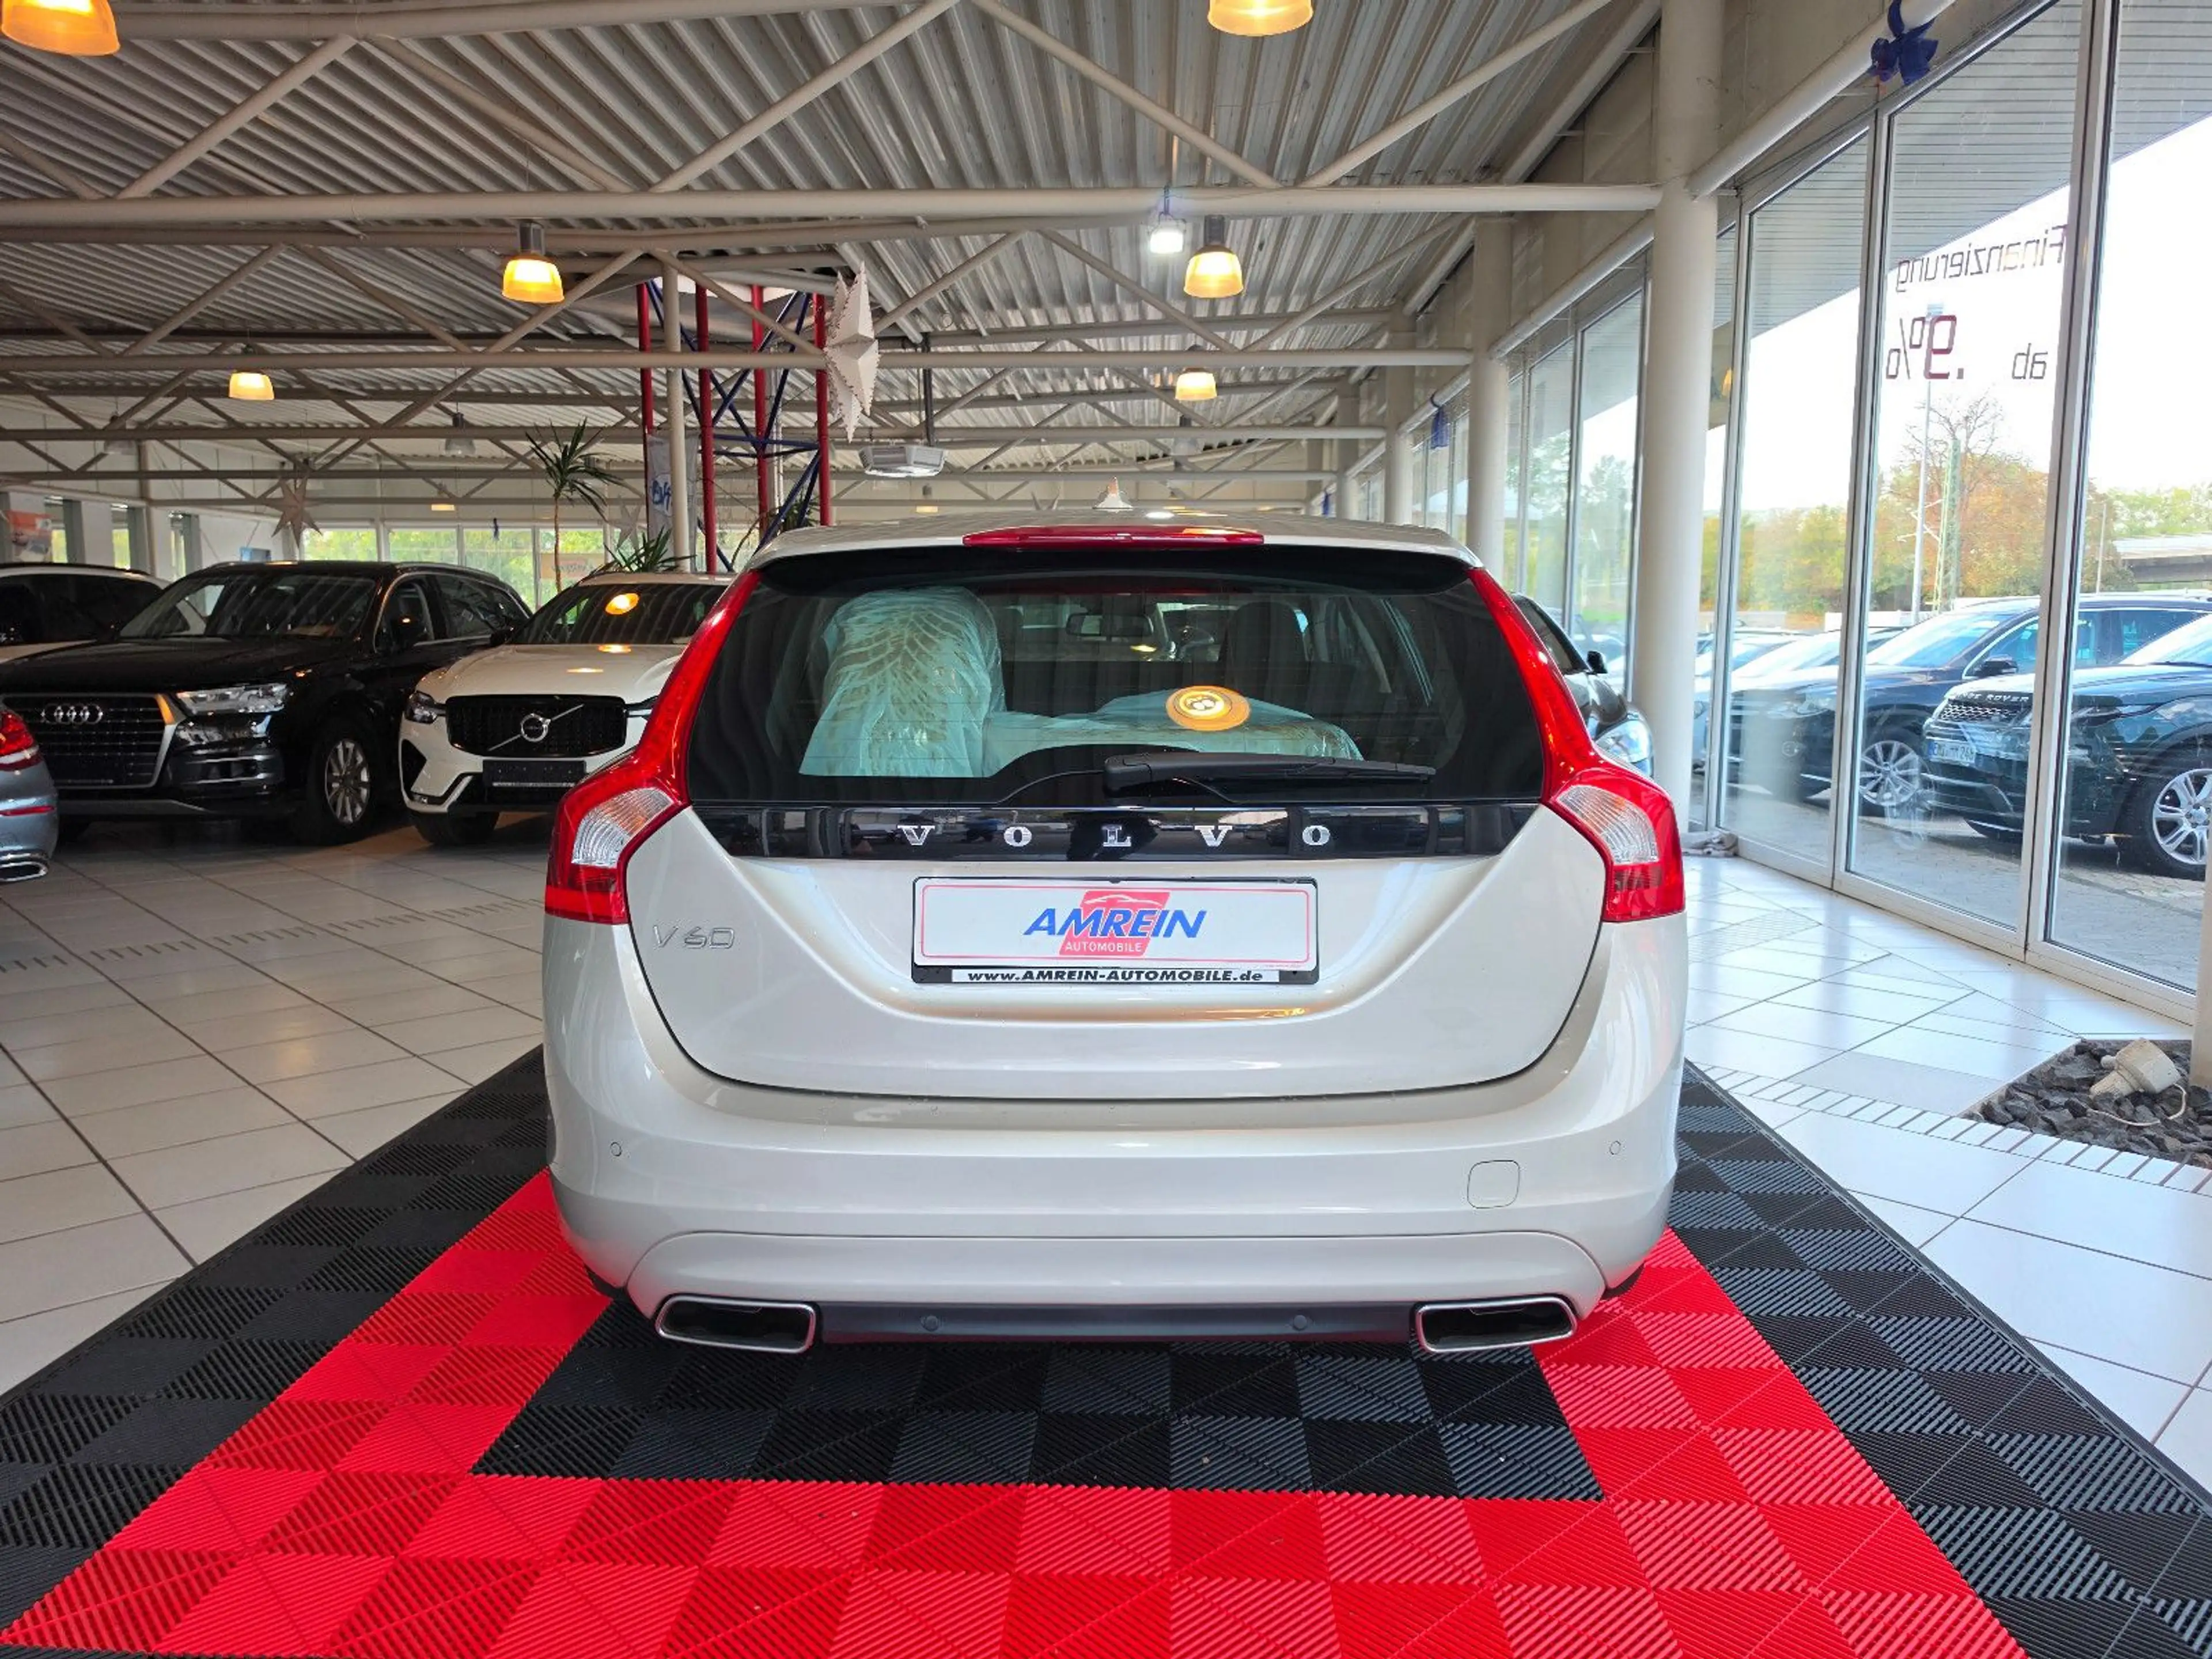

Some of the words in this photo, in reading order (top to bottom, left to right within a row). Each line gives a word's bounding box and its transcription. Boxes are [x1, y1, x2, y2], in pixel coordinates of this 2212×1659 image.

[896, 824, 1331, 847] VOLVO
[1022, 907, 1208, 938] AMREIN
[1065, 941, 1143, 952] AUTOMOBILE
[967, 970, 1264, 982] www.AMREIN-AUTOMOBILE.de
